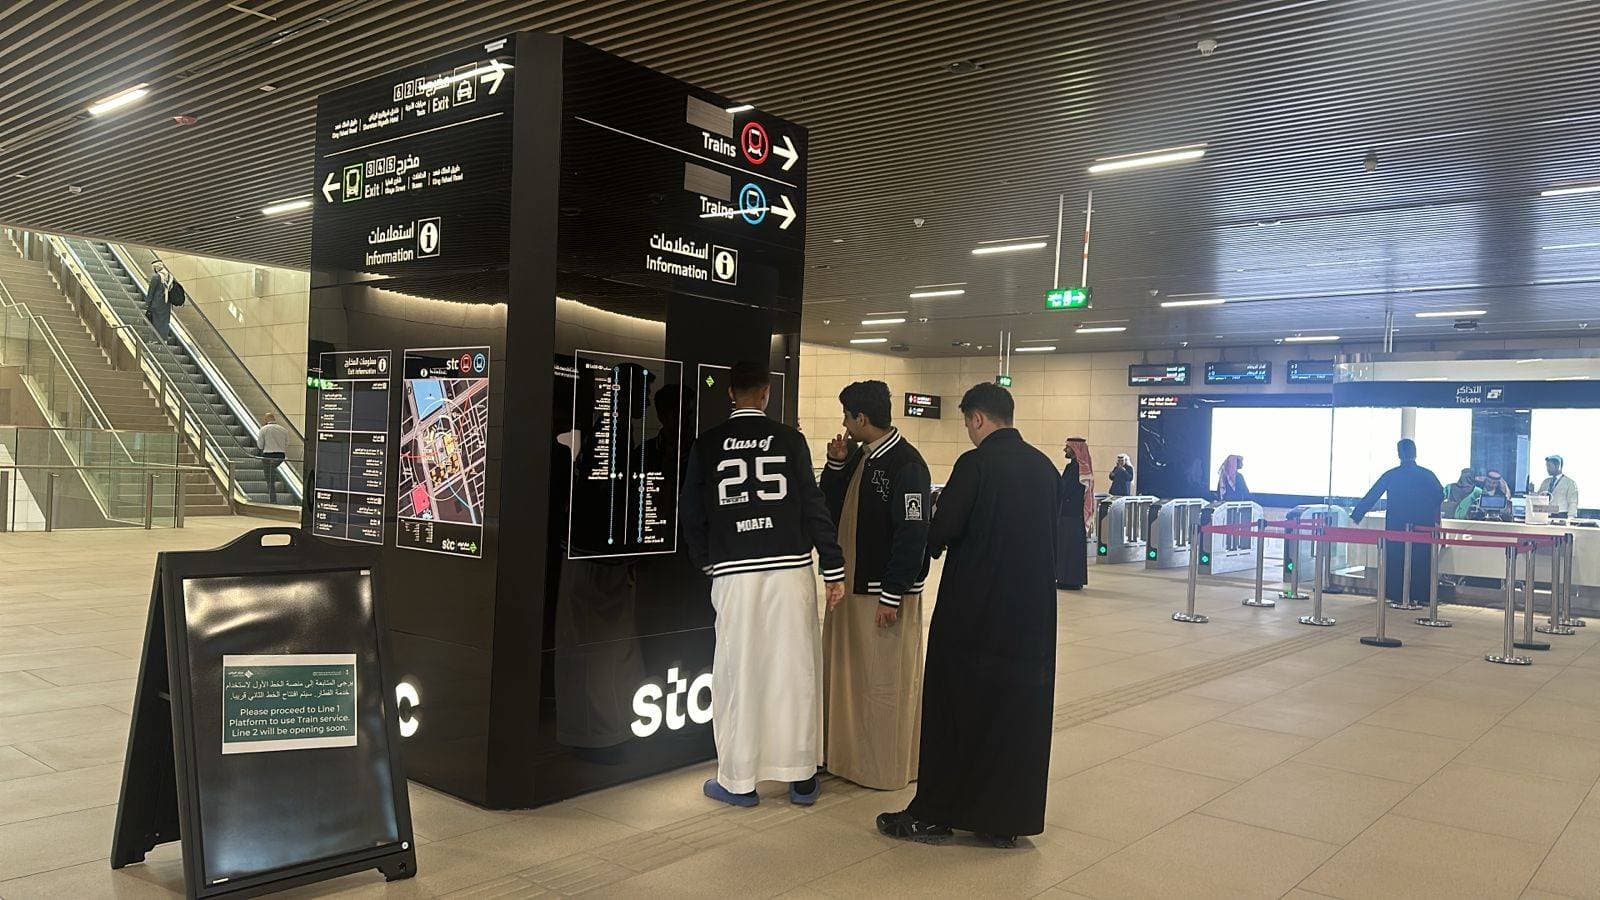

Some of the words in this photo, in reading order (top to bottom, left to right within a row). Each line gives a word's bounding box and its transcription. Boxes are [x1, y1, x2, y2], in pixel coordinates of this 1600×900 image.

[432, 95, 450, 113] Exit
[702, 131, 737, 158] Trains
[396, 153, 420, 176] مخرج
[364, 183, 380, 199] Exit
[700, 195, 734, 219] Trains
[367, 220, 415, 245] استعلامات
[649, 232, 709, 260] استعلامات
[365, 247, 414, 266] Information
[646, 254, 708, 281] Information
[446, 357, 459, 371] stc
[1456, 385, 1482, 395] التذاكر
[1456, 396, 1481, 404] Tickets
[723, 437, 757, 451] Class
[758, 435, 774, 452] of
[717, 456, 788, 506] 25
[736, 517, 774, 533] MOAFA
[240, 708, 269, 716] Please
[270, 705, 305, 716] proceed
[317, 705, 335, 713] Line
[229, 718, 268, 727] Platform
[297, 715, 318, 724] Train
[319, 714, 351, 723] service.
[232, 728, 251, 737] Line
[252, 728, 259, 736] 2
[259, 727, 275, 736] will
[276, 727, 288, 735] be
[289, 725, 324, 735] opening
